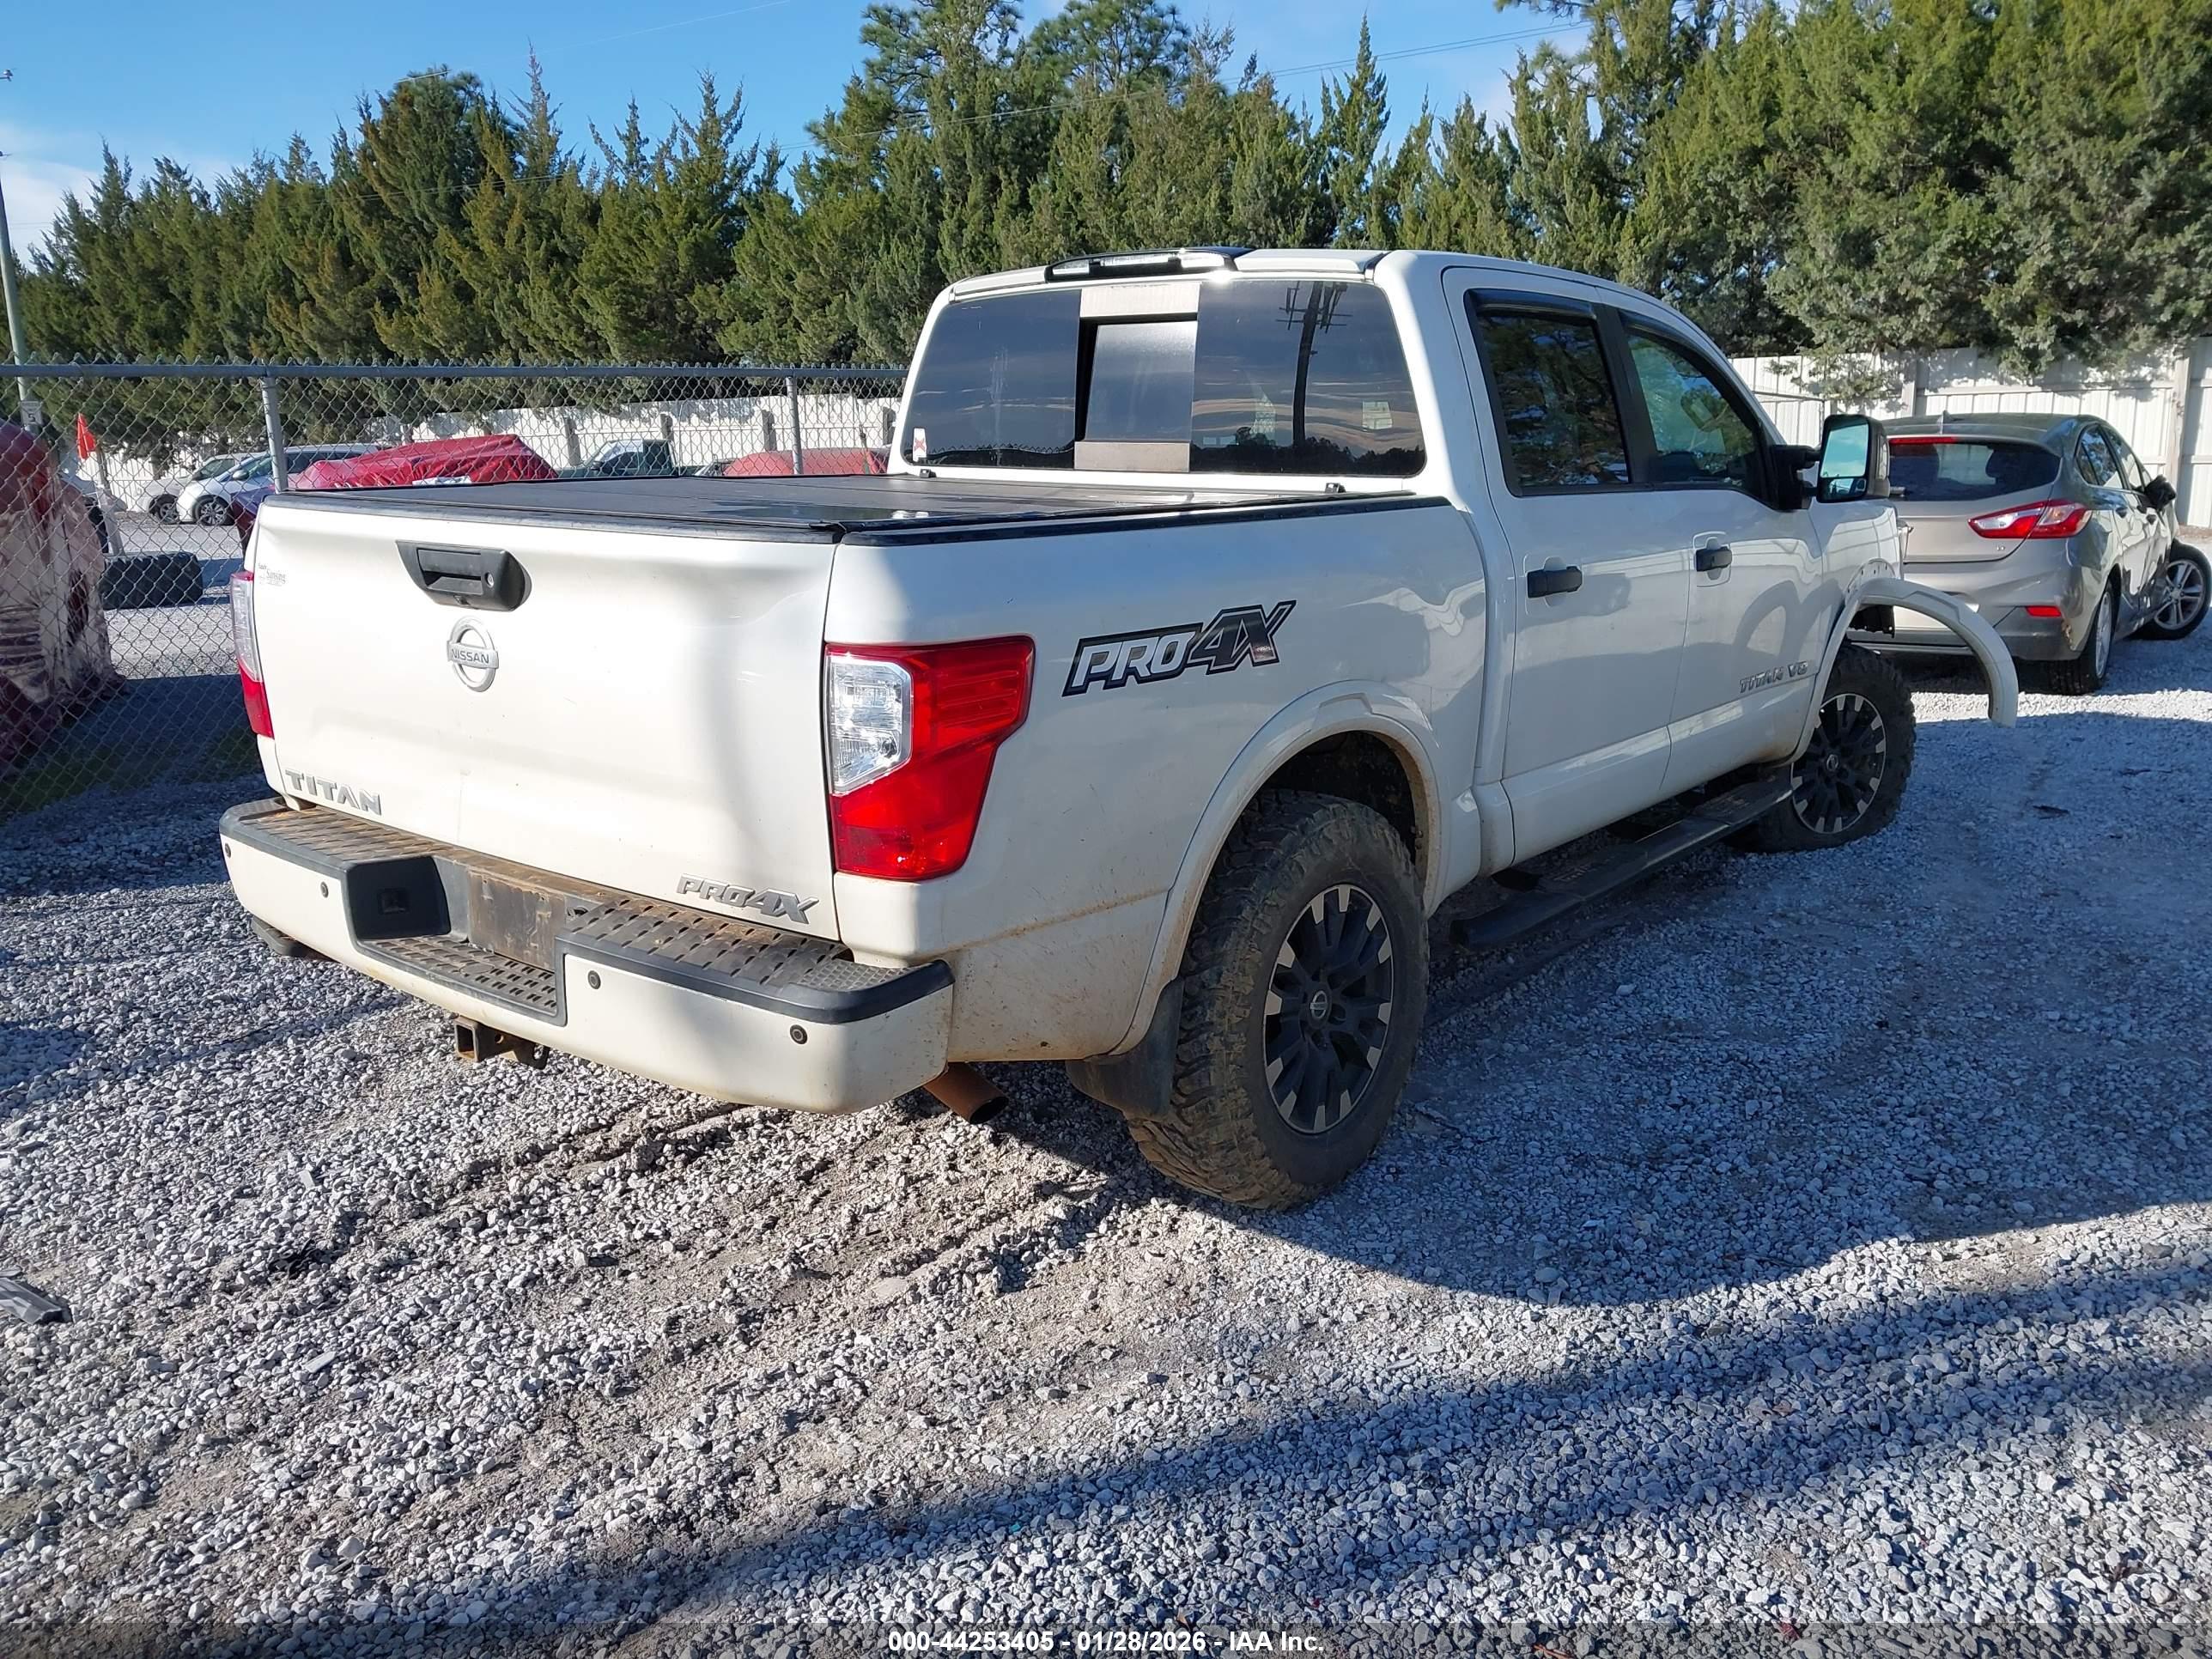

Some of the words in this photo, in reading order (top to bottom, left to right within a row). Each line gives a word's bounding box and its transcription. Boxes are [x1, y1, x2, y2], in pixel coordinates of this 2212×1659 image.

[451, 648, 490, 665] NISSAN
[1060, 599, 1297, 697] PRO4X
[1739, 666, 1784, 694] TITAN
[284, 769, 382, 817] TITAN
[676, 872, 820, 925] PRO4X
